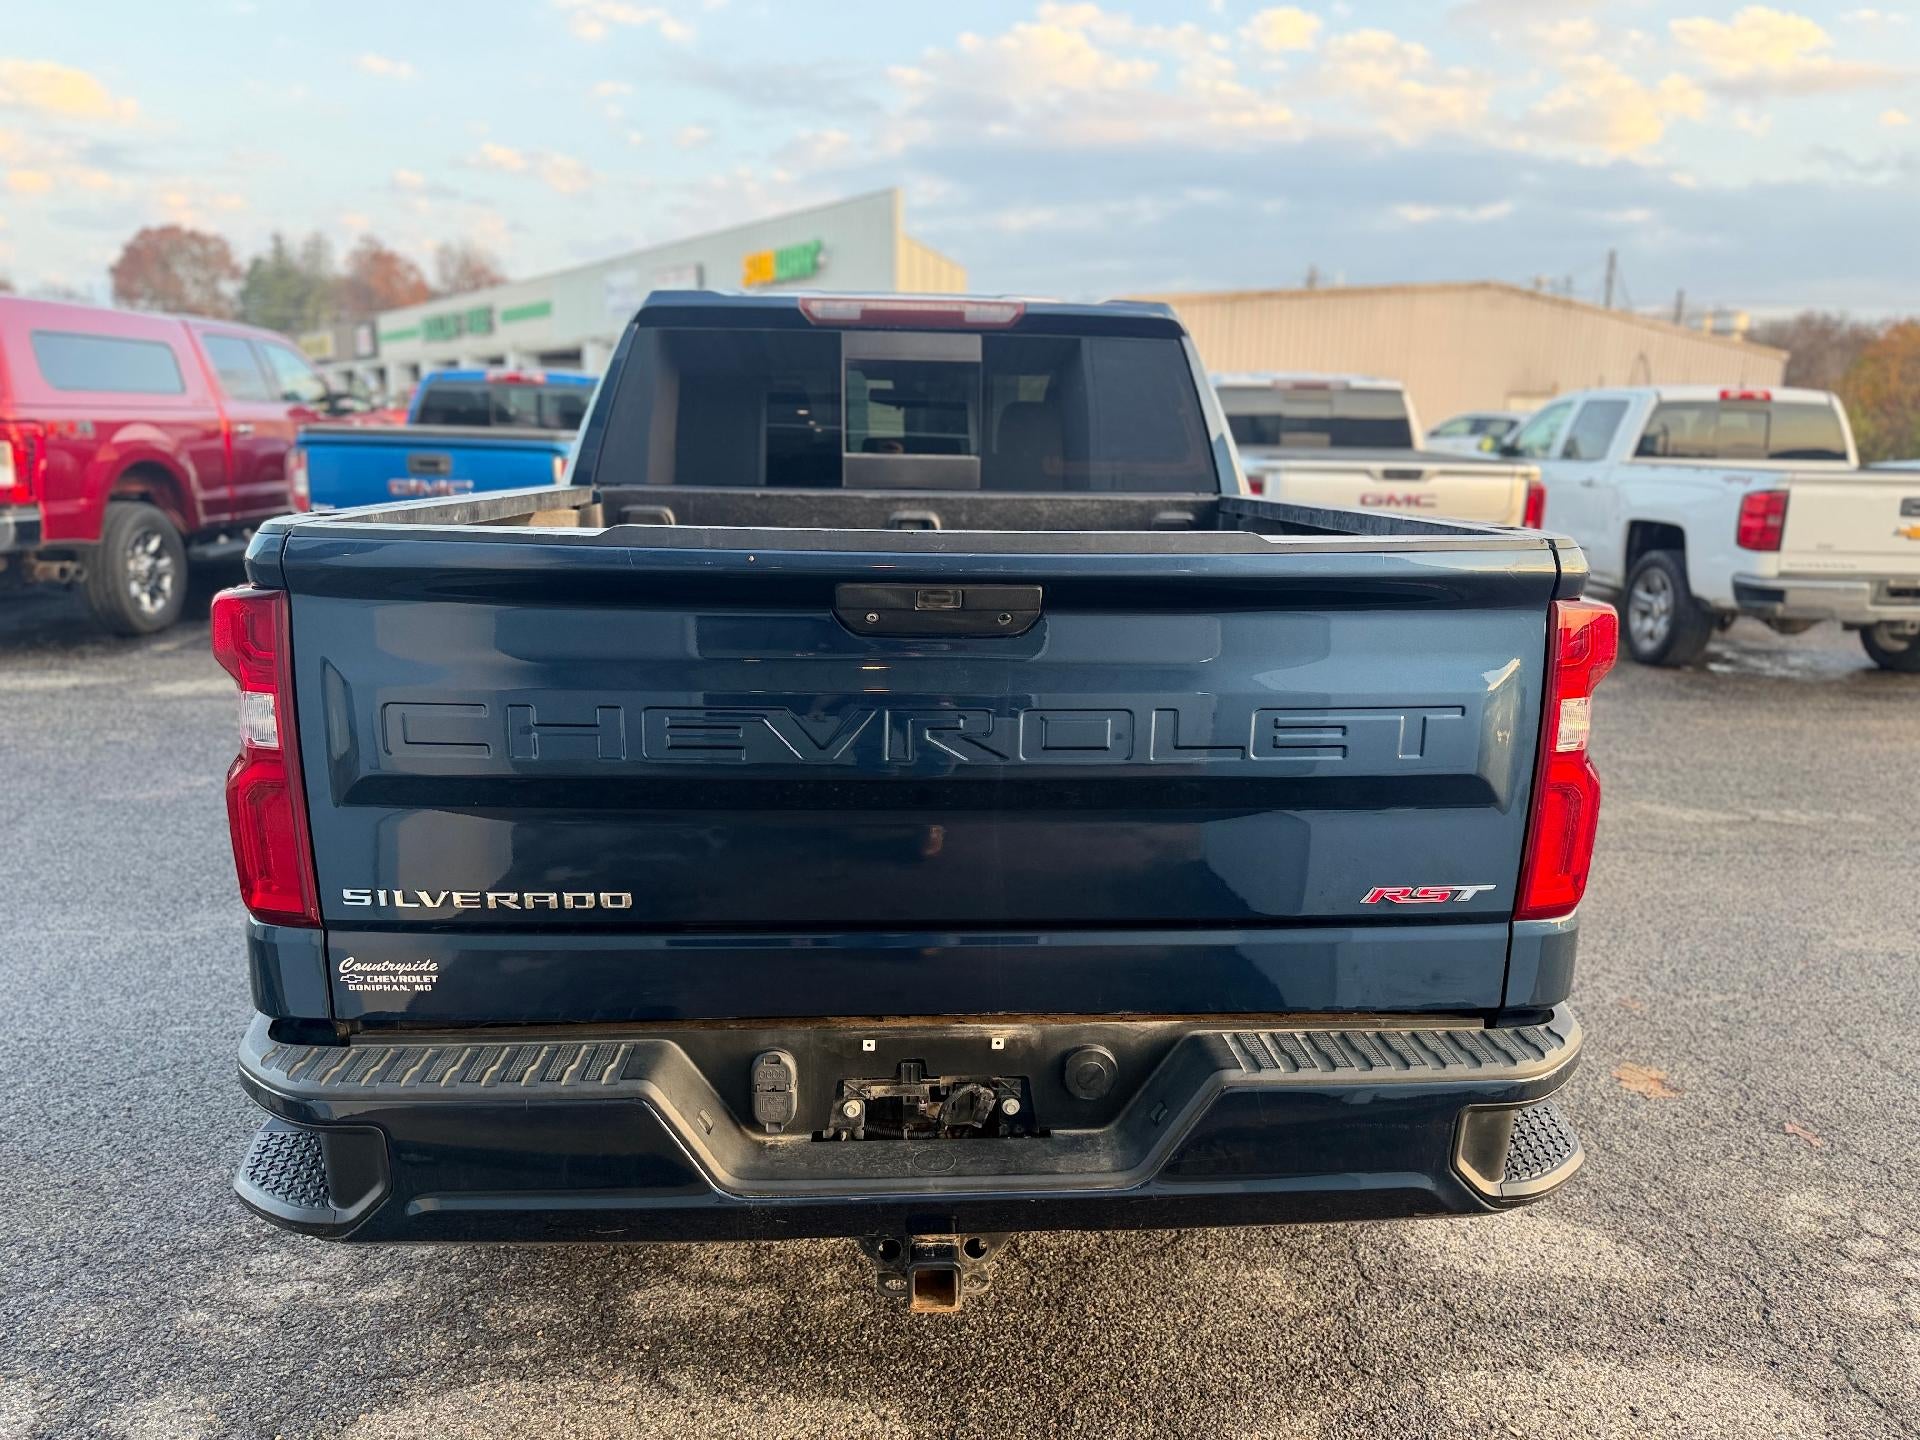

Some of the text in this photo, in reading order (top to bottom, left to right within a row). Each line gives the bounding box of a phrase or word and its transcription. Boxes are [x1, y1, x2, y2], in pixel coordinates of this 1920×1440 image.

[388, 479, 474, 497] GMC
[1360, 493, 1438, 508] GMC
[381, 704, 1467, 764] CHEVROLET
[342, 888, 632, 910] SILVERADO
[1360, 884, 1496, 904] RST
[338, 956, 439, 975] Countryside
[366, 975, 439, 984] CHEVROLET
[414, 984, 433, 992] MO
